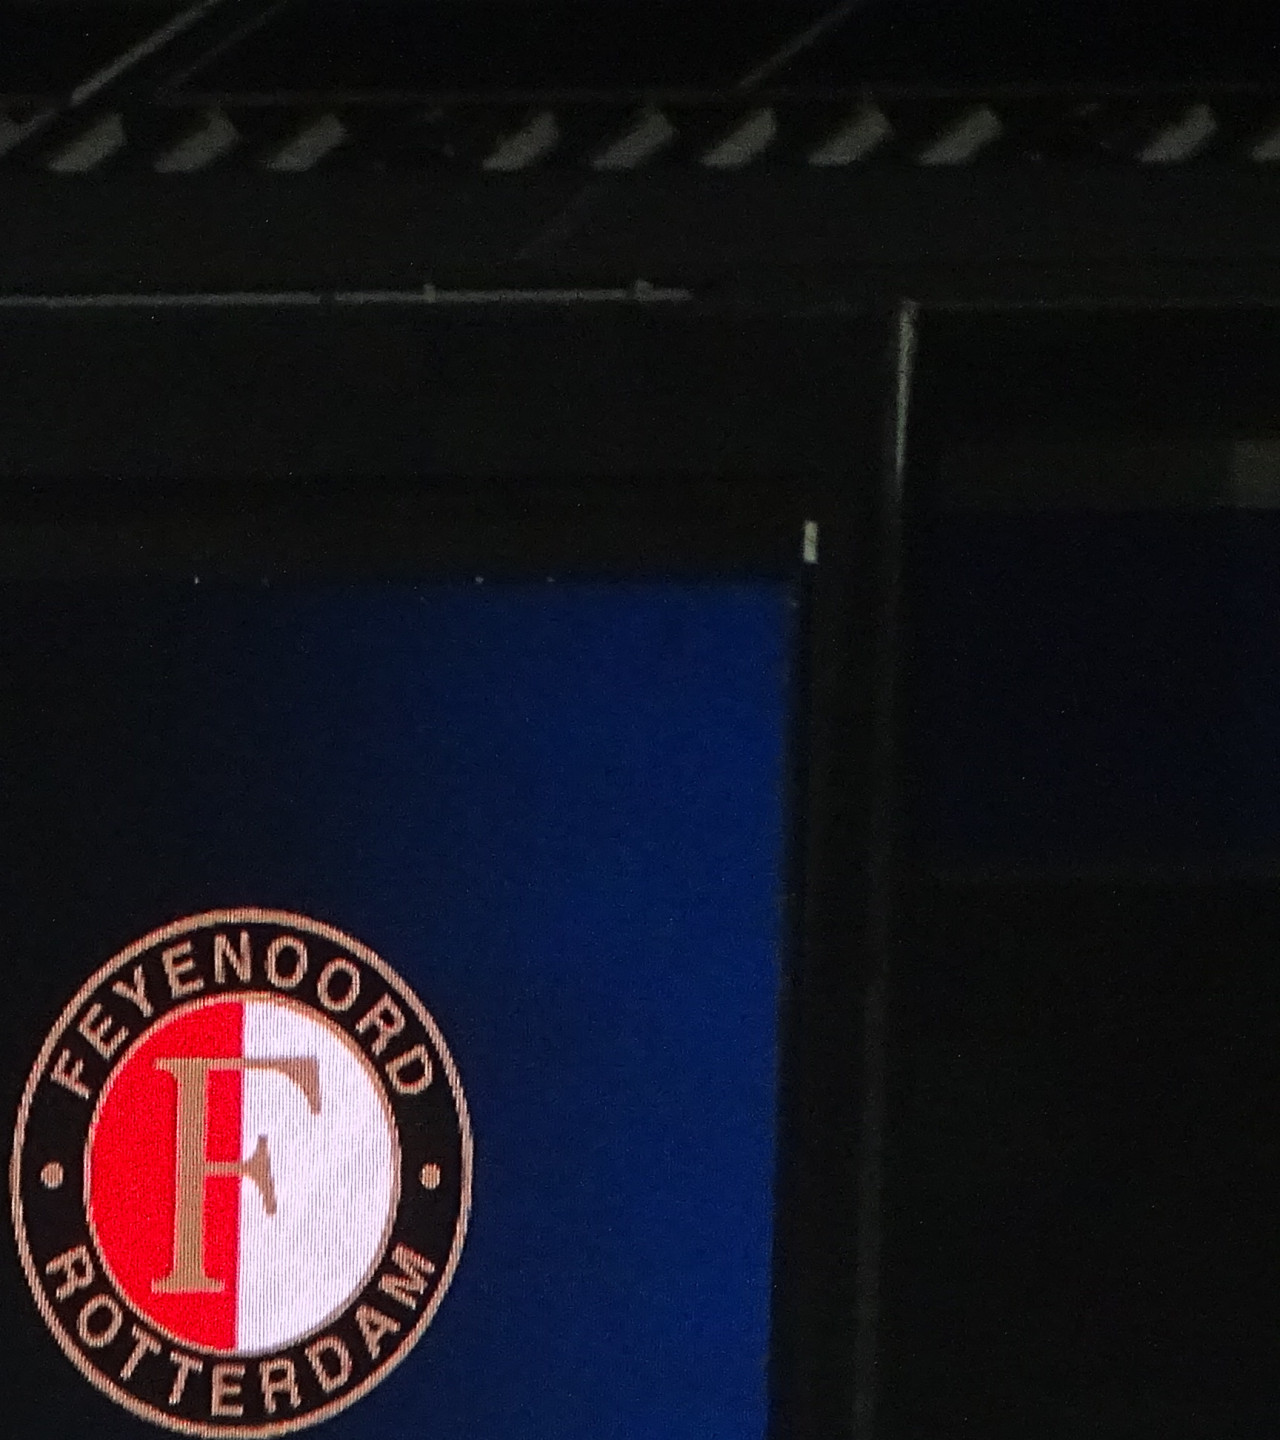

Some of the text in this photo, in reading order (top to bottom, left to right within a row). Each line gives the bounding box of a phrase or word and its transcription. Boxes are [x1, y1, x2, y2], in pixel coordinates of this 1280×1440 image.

[49, 930, 435, 1100] FEYENOORD
[151, 1055, 322, 1295] F
[44, 1241, 437, 1418] ROTTERDAM
